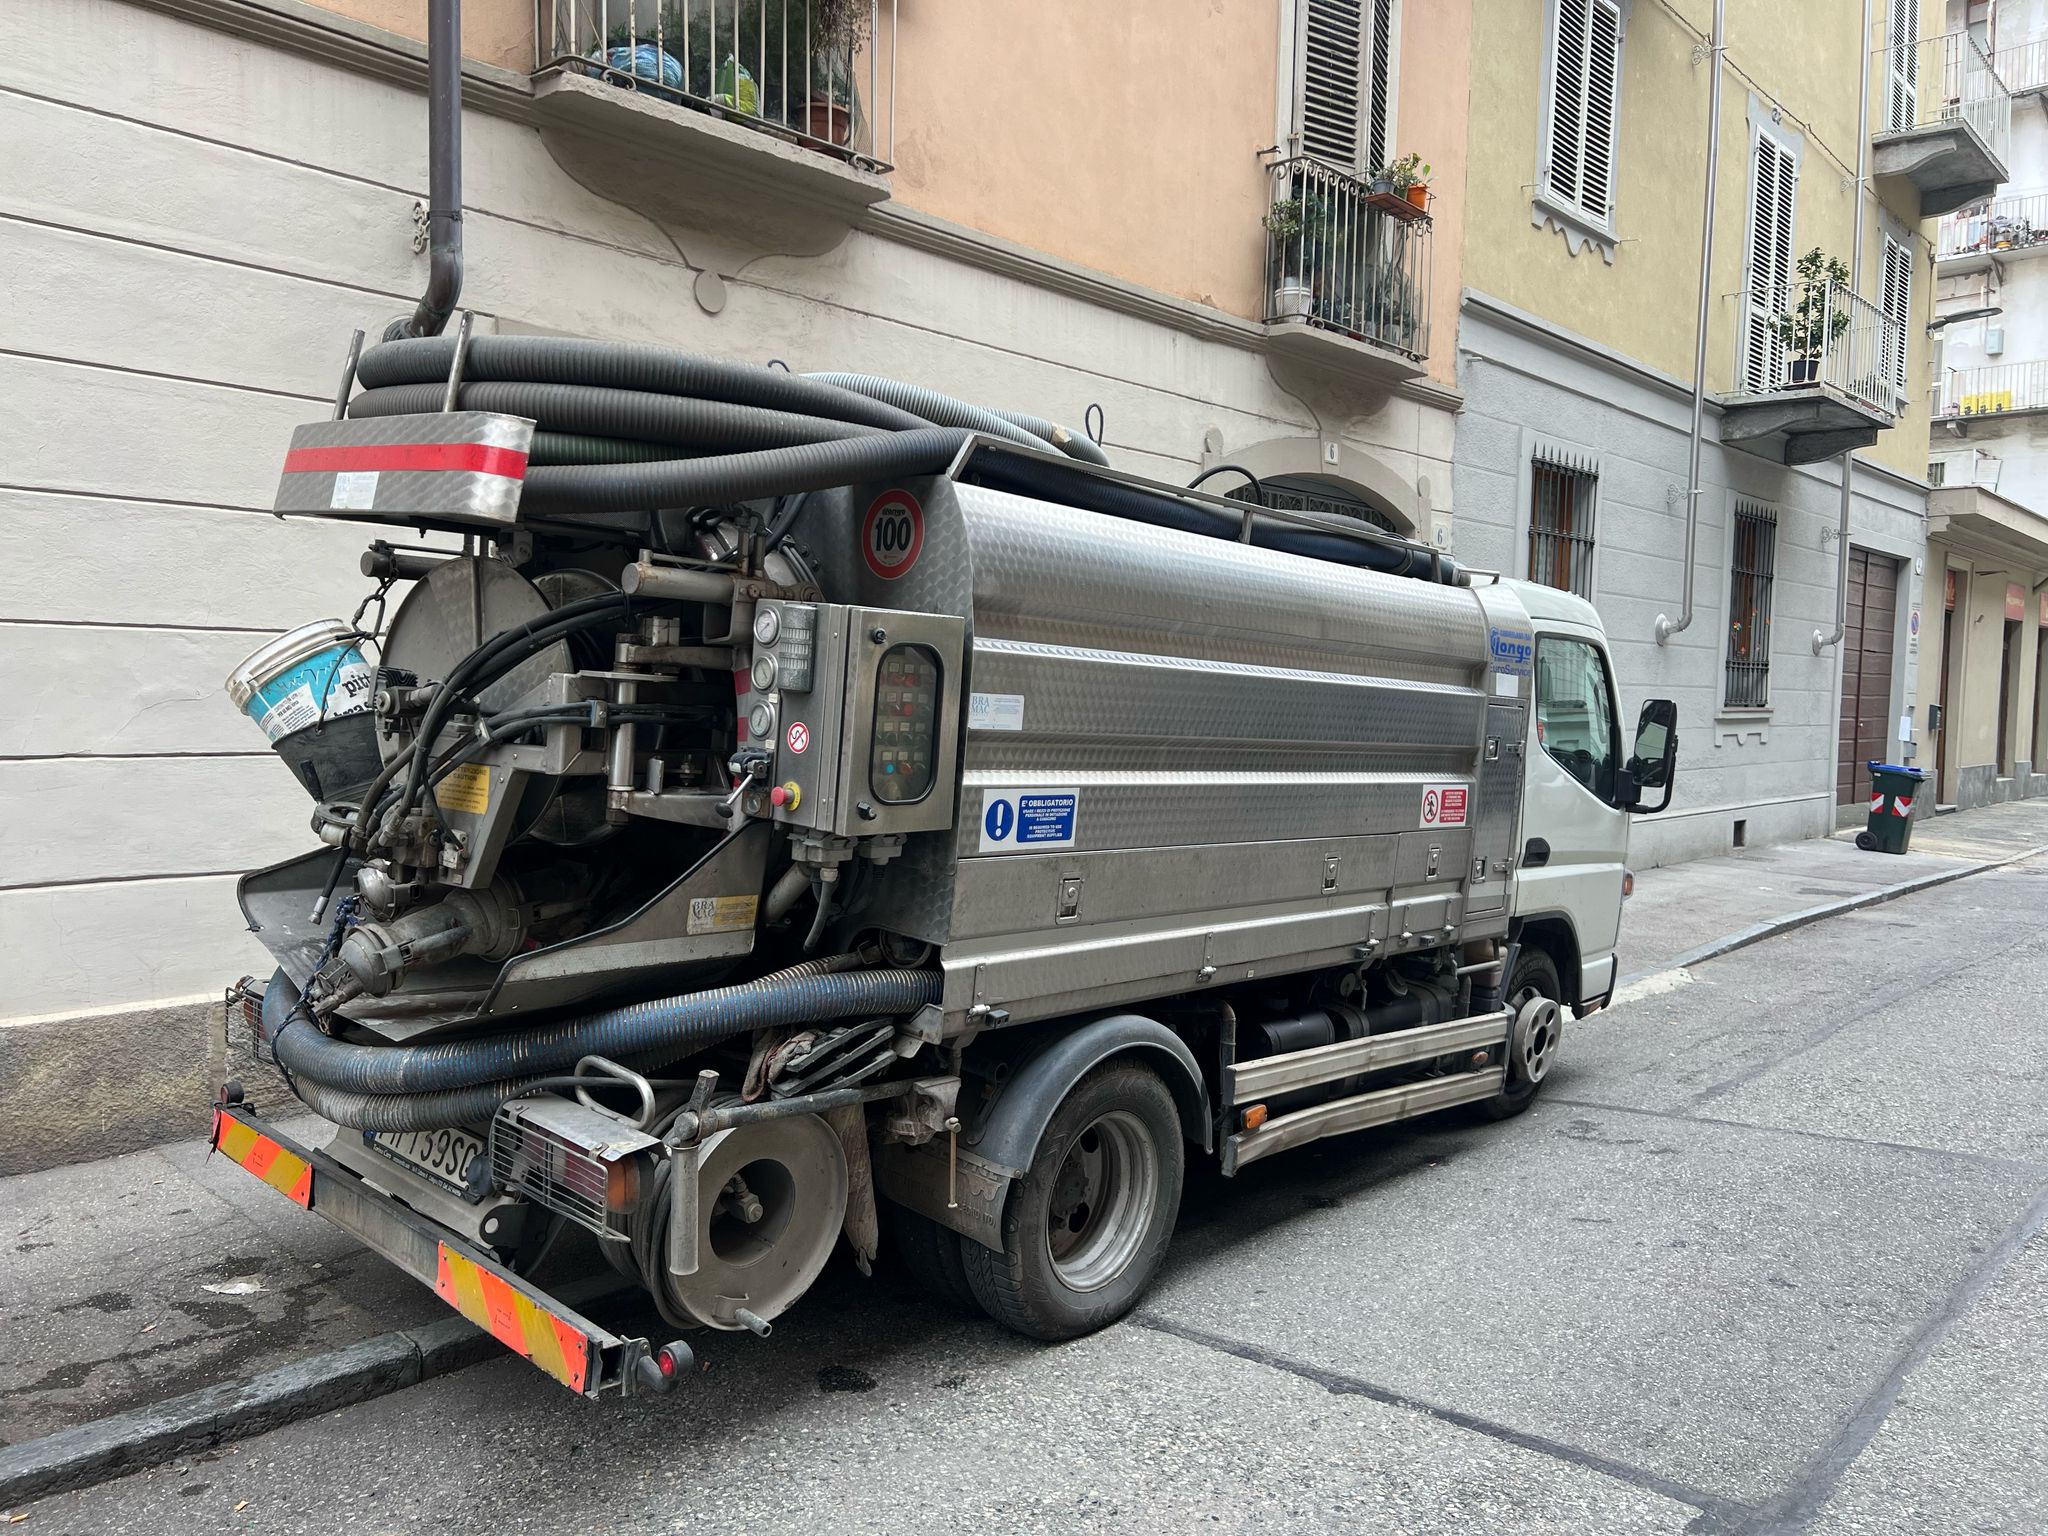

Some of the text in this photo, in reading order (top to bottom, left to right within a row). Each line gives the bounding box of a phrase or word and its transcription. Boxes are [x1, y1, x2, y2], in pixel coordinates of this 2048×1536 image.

[1329, 443, 1335, 460] 6
[876, 516, 911, 552] 100
[1437, 527, 1443, 545] 6
[972, 695, 990, 706] BRA
[1028, 798, 1074, 807] OBBLIGATORIO
